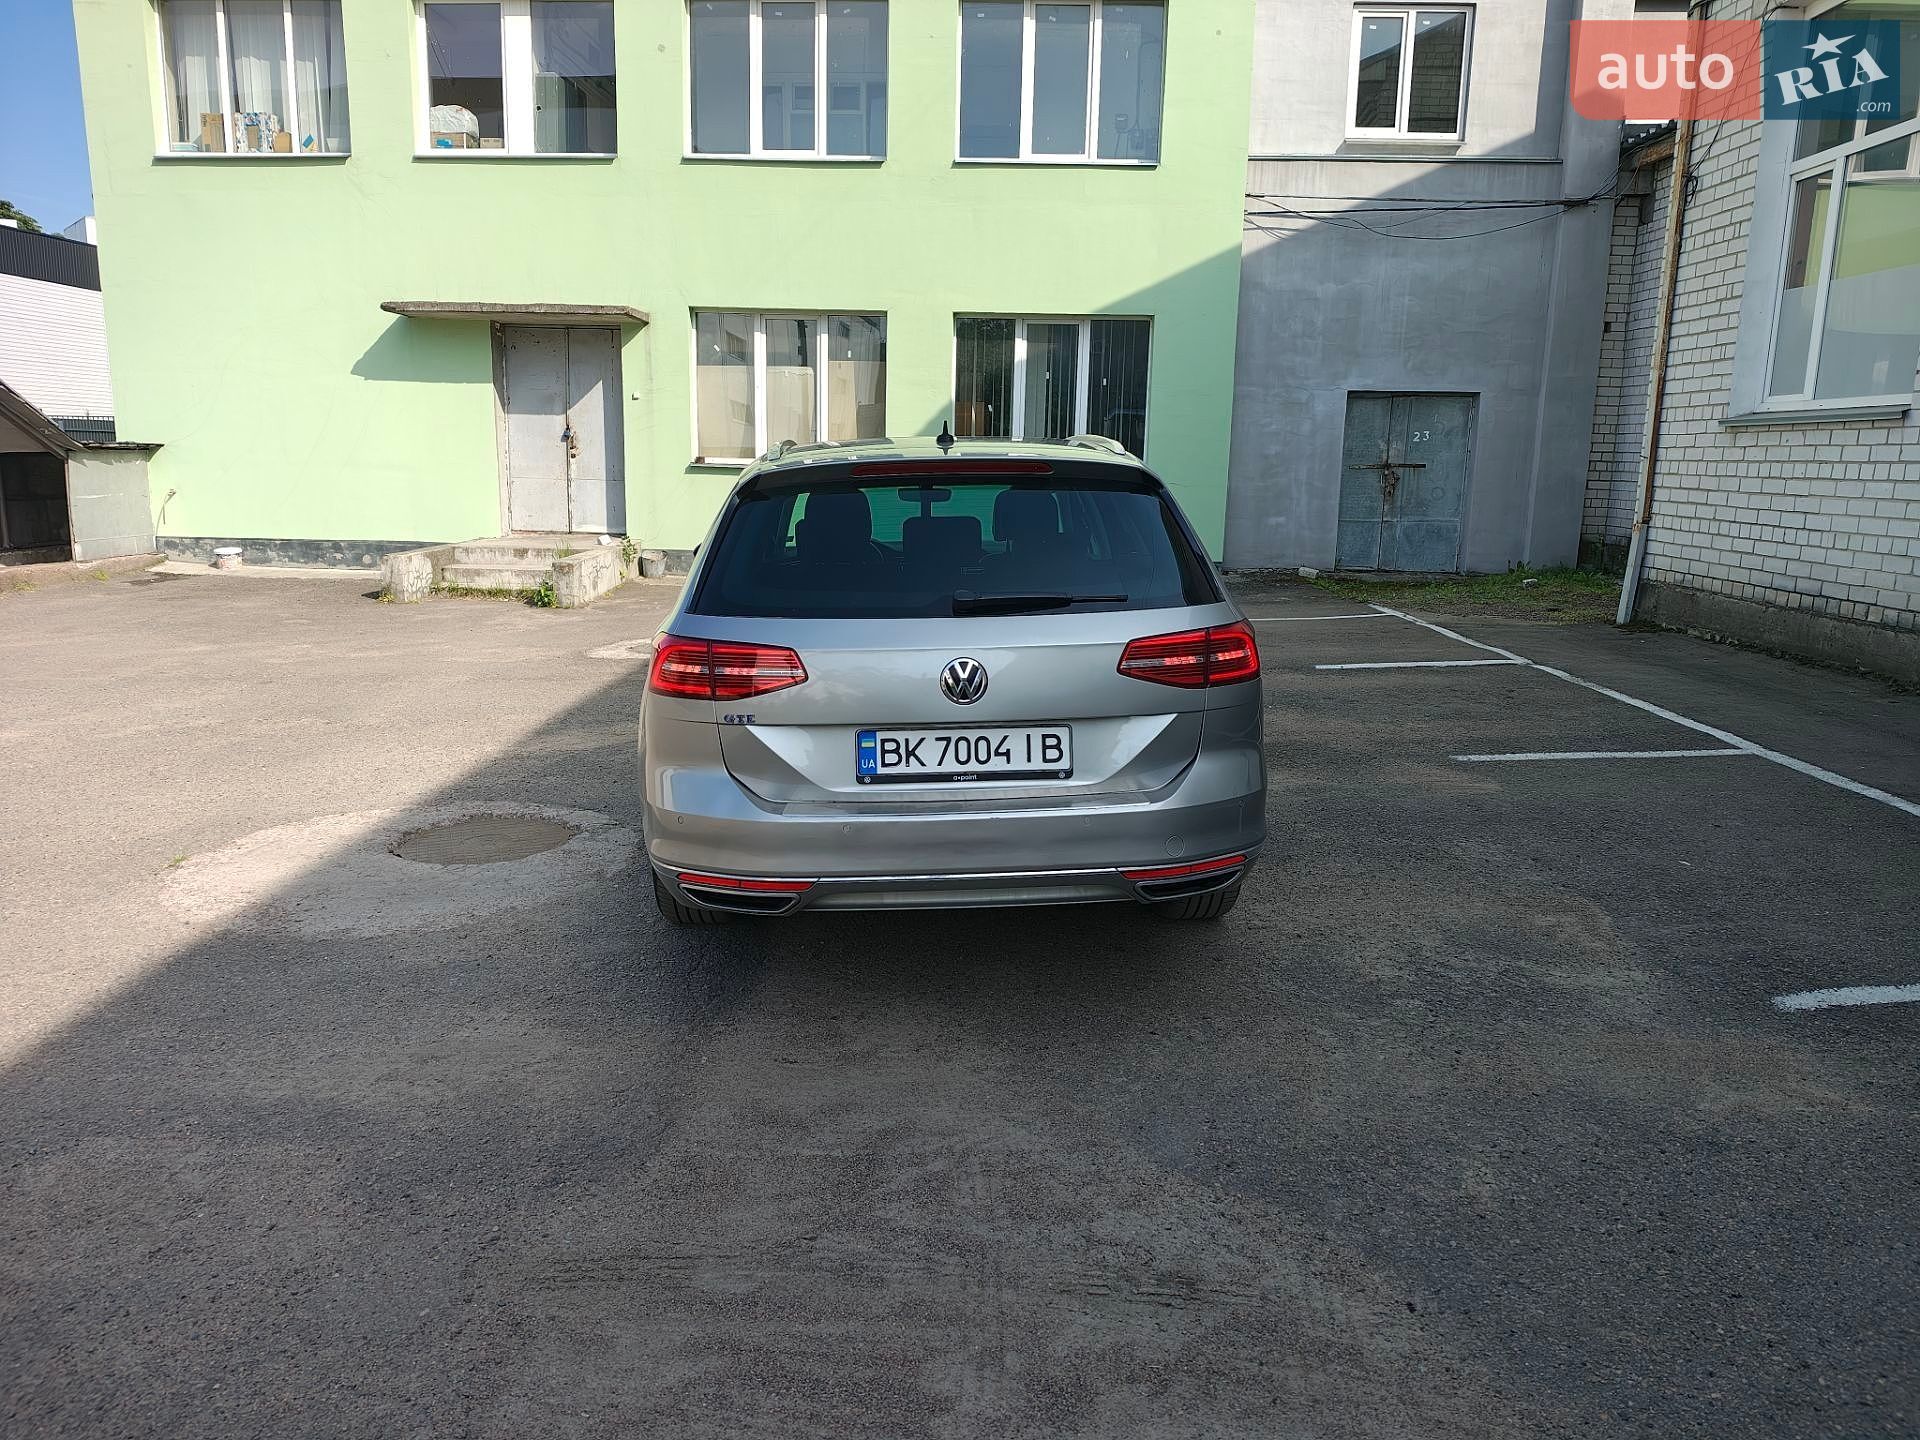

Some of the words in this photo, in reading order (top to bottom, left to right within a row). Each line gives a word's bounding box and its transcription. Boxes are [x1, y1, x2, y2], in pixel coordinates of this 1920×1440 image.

[1412, 430, 1430, 442] 23
[723, 714, 756, 724] GTE
[880, 737, 928, 768] BK
[934, 735, 1011, 766] 7004
[1025, 733, 1064, 764] IB
[861, 758, 875, 768] UA
